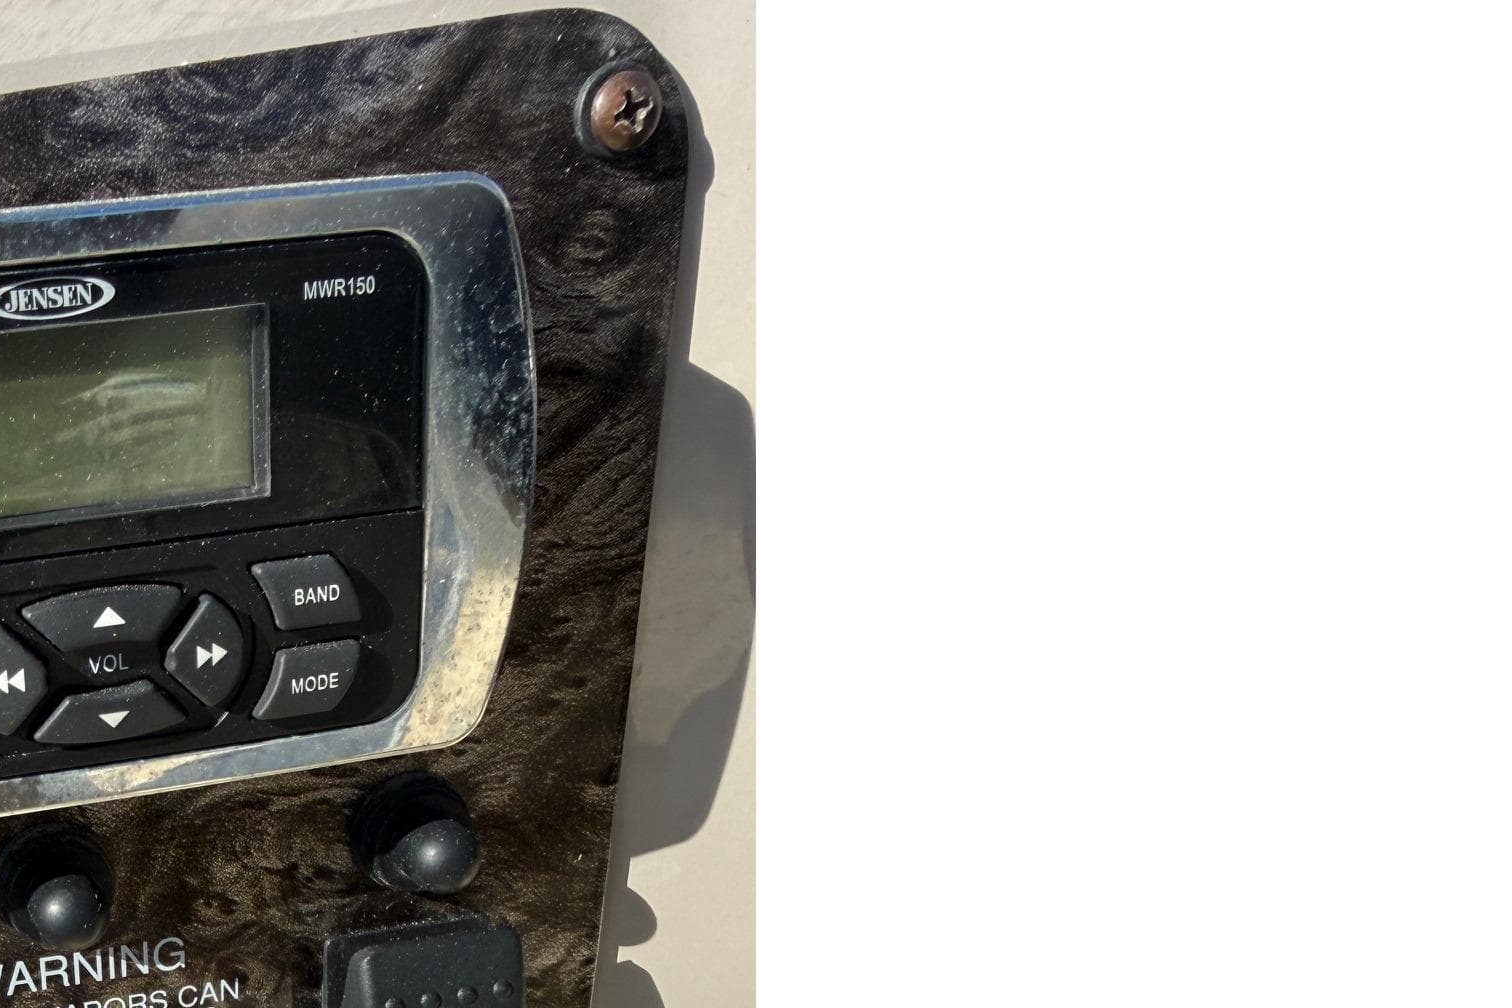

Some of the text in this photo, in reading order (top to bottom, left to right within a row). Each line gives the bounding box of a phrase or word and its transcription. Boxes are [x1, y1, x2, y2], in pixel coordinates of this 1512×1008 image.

[4, 283, 94, 312] JENSEN
[303, 275, 376, 300] MWR150
[293, 584, 341, 606] BAND
[88, 653, 130, 674] VOL
[291, 672, 340, 694] MODE
[178, 979, 240, 1008] CAN
